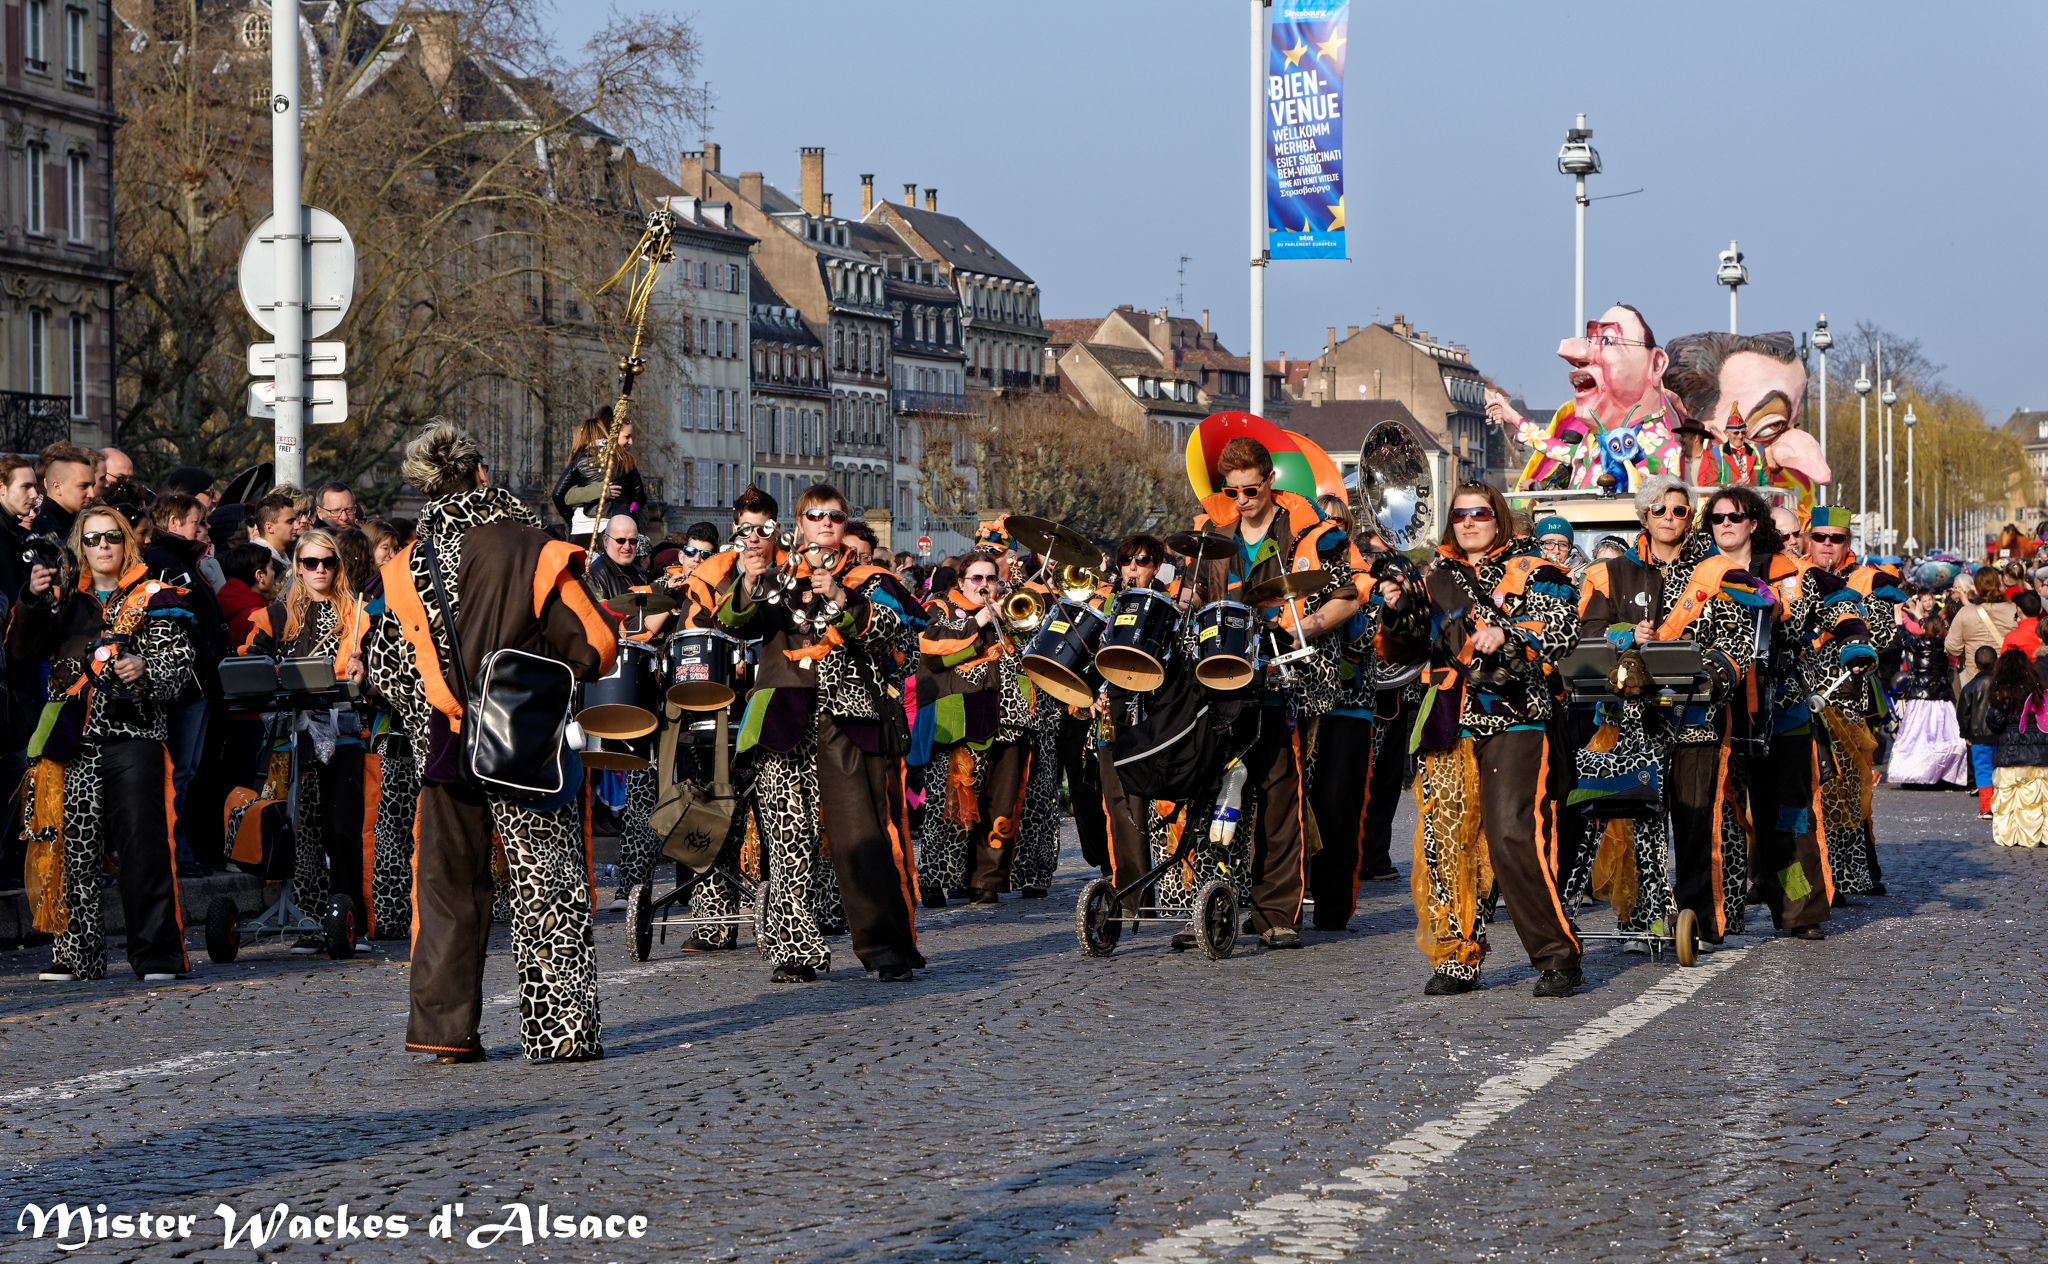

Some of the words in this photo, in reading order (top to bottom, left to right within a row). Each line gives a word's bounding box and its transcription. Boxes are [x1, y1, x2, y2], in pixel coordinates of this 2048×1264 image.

[1270, 70, 1327, 101] BIEN-
[1270, 93, 1340, 126] VENUE
[1272, 121, 1330, 142] WËLLKOMM
[1275, 138, 1317, 156] MERHBA
[1276, 155, 1298, 168] ESIET
[1299, 149, 1342, 165] SVEICINATI
[1277, 163, 1322, 179] BEM-VINDO
